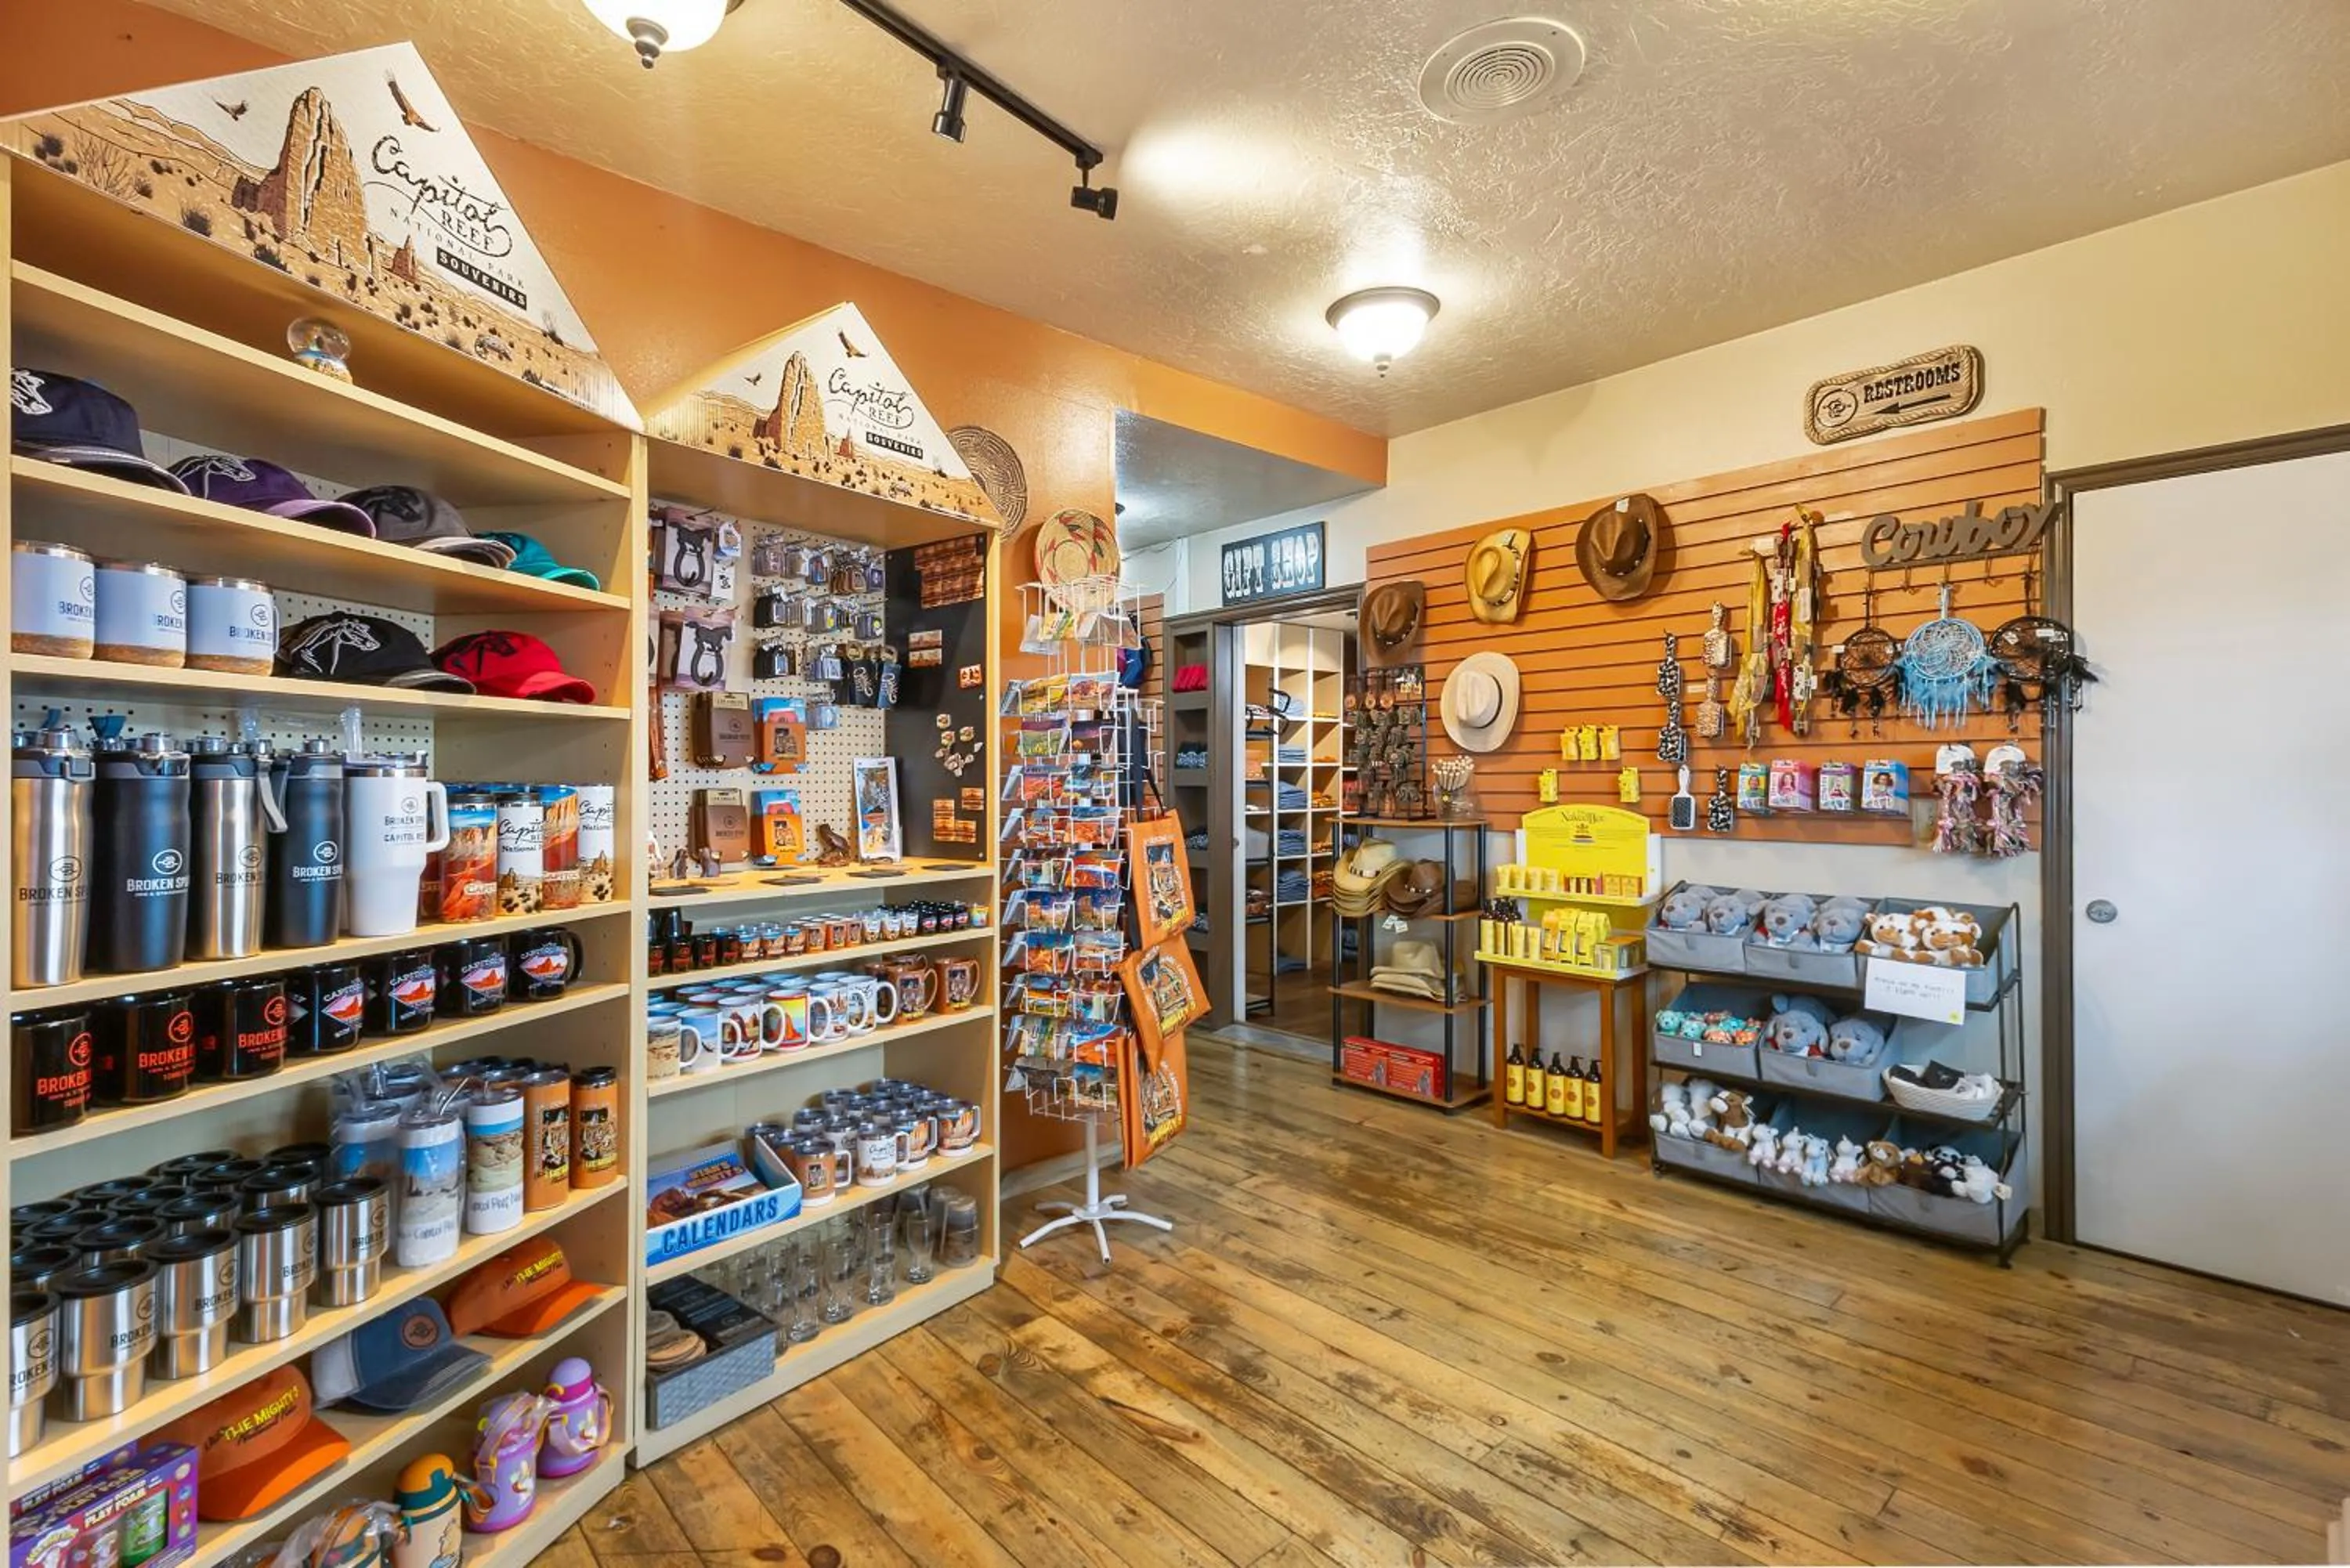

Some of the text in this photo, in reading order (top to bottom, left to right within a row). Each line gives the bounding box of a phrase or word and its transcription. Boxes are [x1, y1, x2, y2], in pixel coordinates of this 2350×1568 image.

[371, 135, 512, 237] Capitol
[391, 207, 525, 289] NATIONAL PARK
[441, 209, 494, 251] REEF
[439, 250, 526, 307] SOUVENIRS
[829, 367, 913, 415] Capitol
[1864, 362, 1961, 403] RESTROOMS
[869, 406, 902, 425] REEF
[866, 432, 923, 459] SOUVENIRS
[1861, 500, 2066, 566] Cowboy
[1224, 533, 1319, 599] GIFT SHOP
[127, 877, 174, 892] BROKEN
[292, 865, 331, 878] BROKEN
[19, 887, 71, 901] BROKEN
[139, 1046, 188, 1068] BROKEN
[38, 1069, 91, 1096] BROKEN
[663, 1196, 778, 1255] CALENDARS
[9, 1360, 49, 1386] ROKEN
